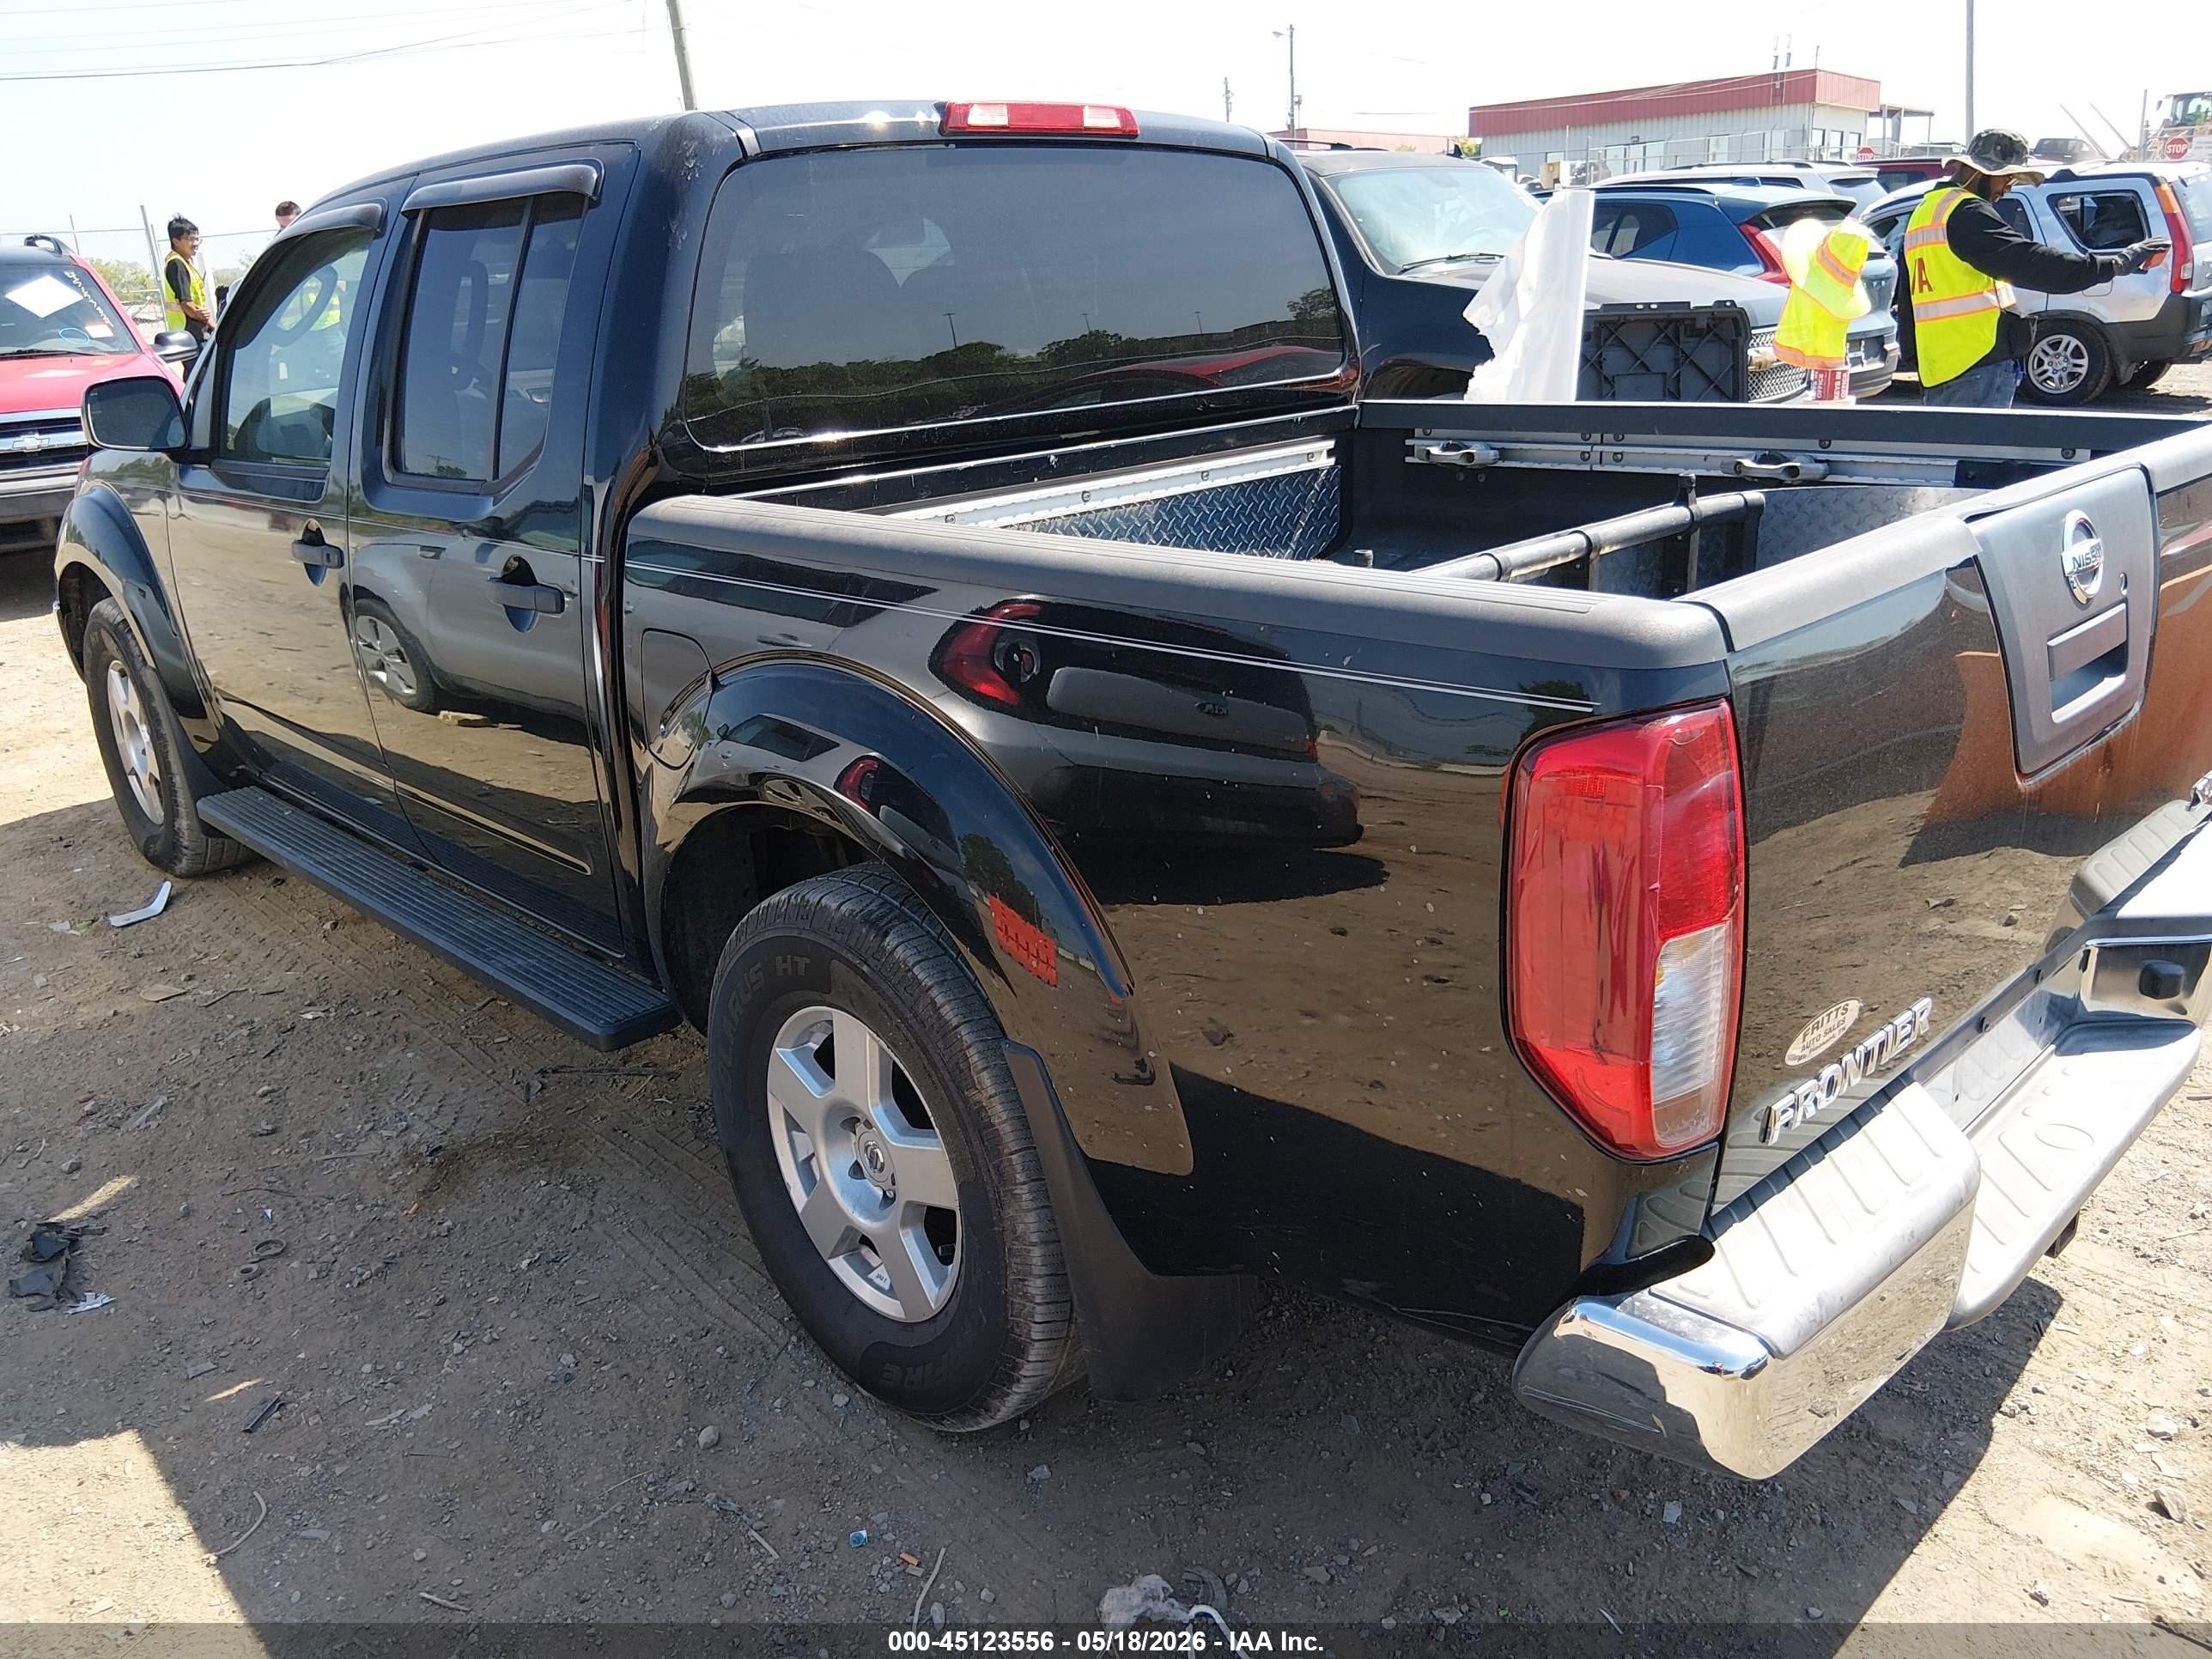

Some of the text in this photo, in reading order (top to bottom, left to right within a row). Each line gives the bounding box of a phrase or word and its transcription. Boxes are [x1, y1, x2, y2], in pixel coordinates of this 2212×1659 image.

[1857, 153, 1874, 161] STOP
[2166, 144, 2187, 154] STOP
[775, 955, 811, 976] HT
[1801, 1002, 1850, 1043] FRITTS
[1801, 1017, 1846, 1053] AUTO SALES
[1759, 997, 1932, 1146] FRONTIER
